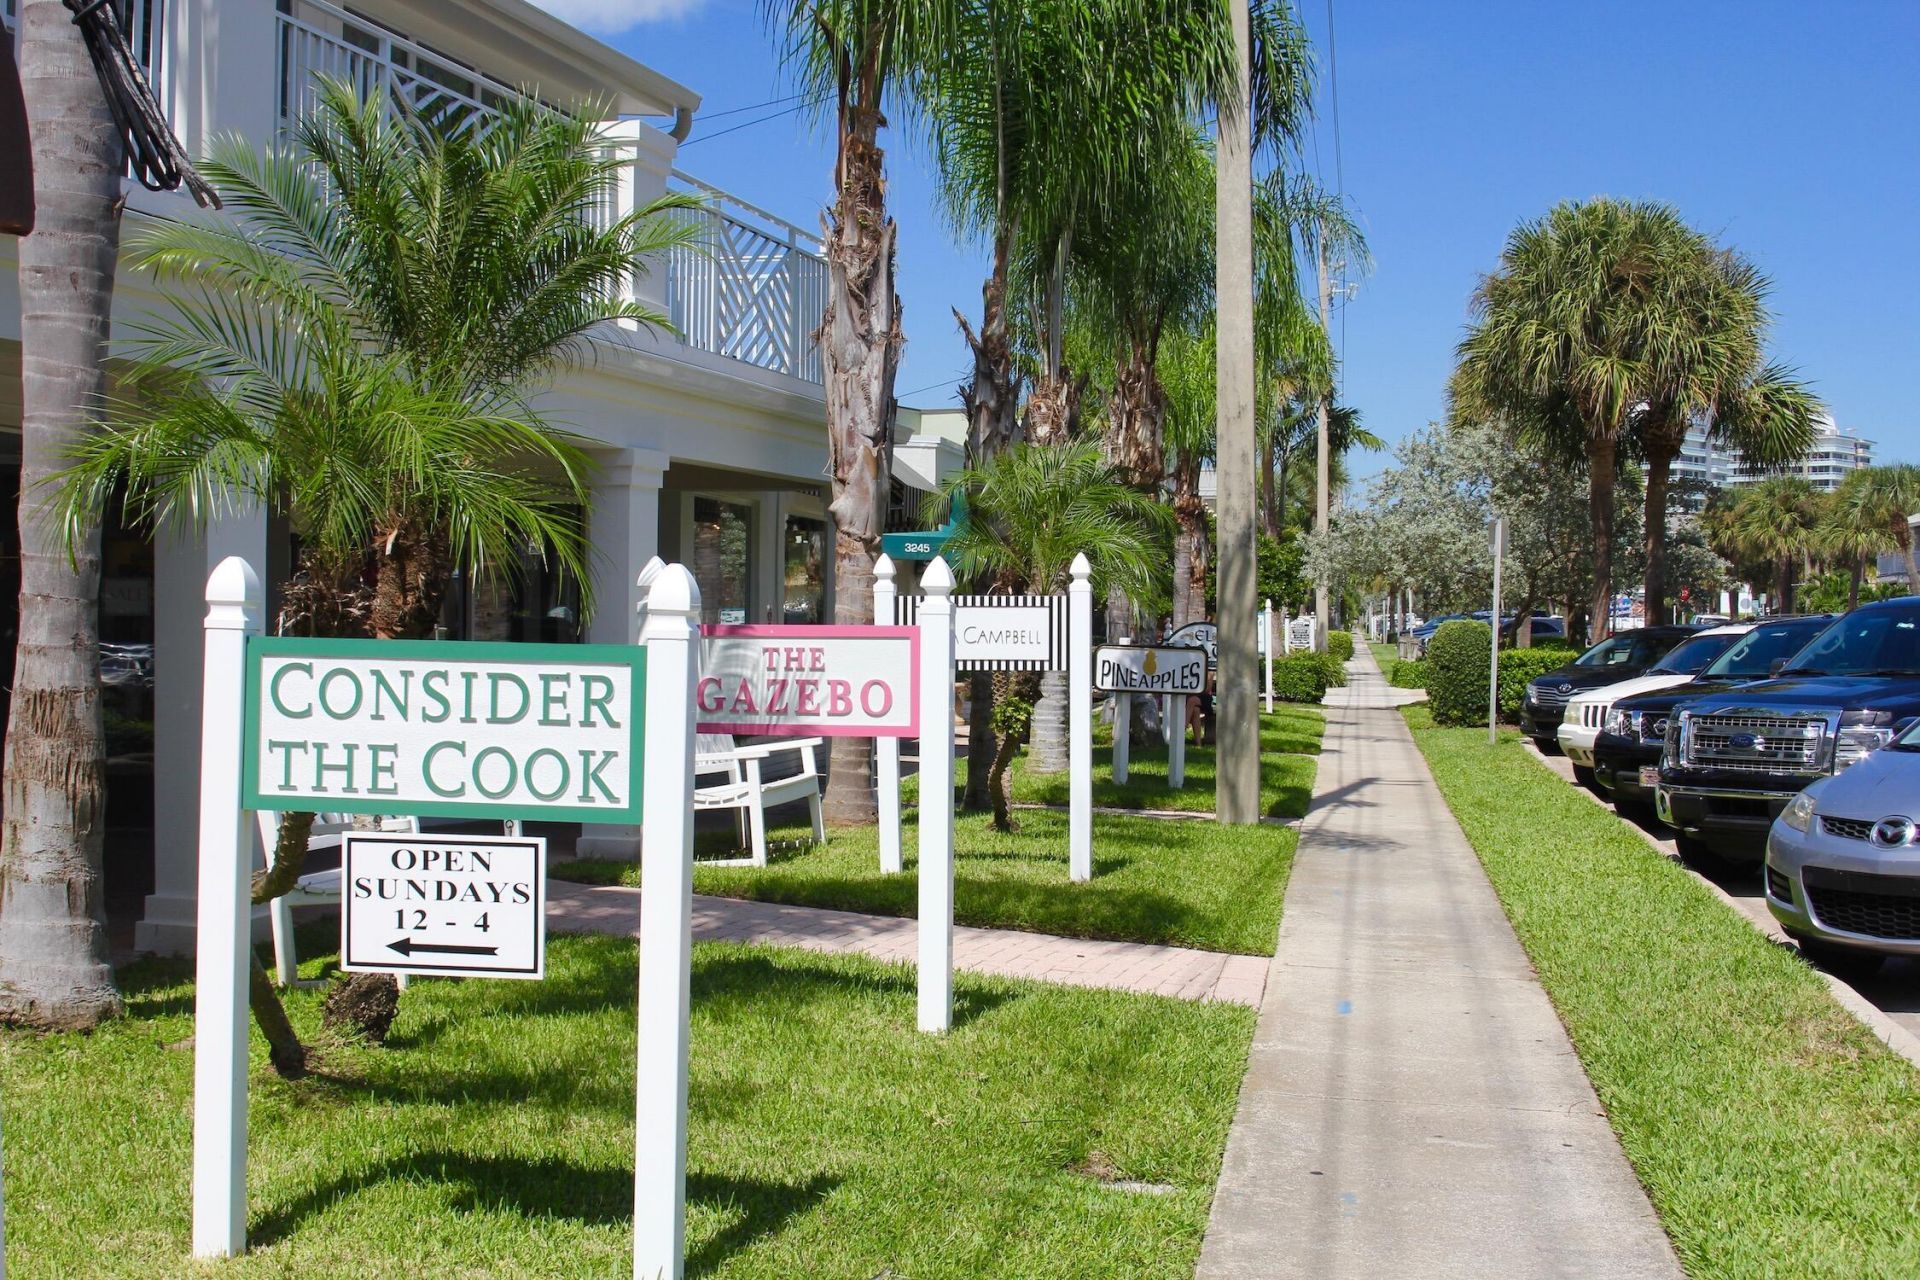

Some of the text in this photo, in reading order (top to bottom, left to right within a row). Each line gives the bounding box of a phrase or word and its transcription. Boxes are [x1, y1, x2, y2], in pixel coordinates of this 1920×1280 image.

[904, 542, 931, 554] 3245
[963, 625, 1041, 646] CAMPBELL
[762, 647, 826, 673] THE
[1100, 659, 1201, 690] PINEAPPLES
[270, 661, 622, 729] CONSIDER
[696, 676, 894, 719] GAZEBO
[267, 738, 621, 804] THE COOK
[390, 848, 494, 873] OPEN
[354, 876, 531, 905] SUNDAYS
[394, 908, 429, 931] 12
[473, 911, 491, 933] 4
